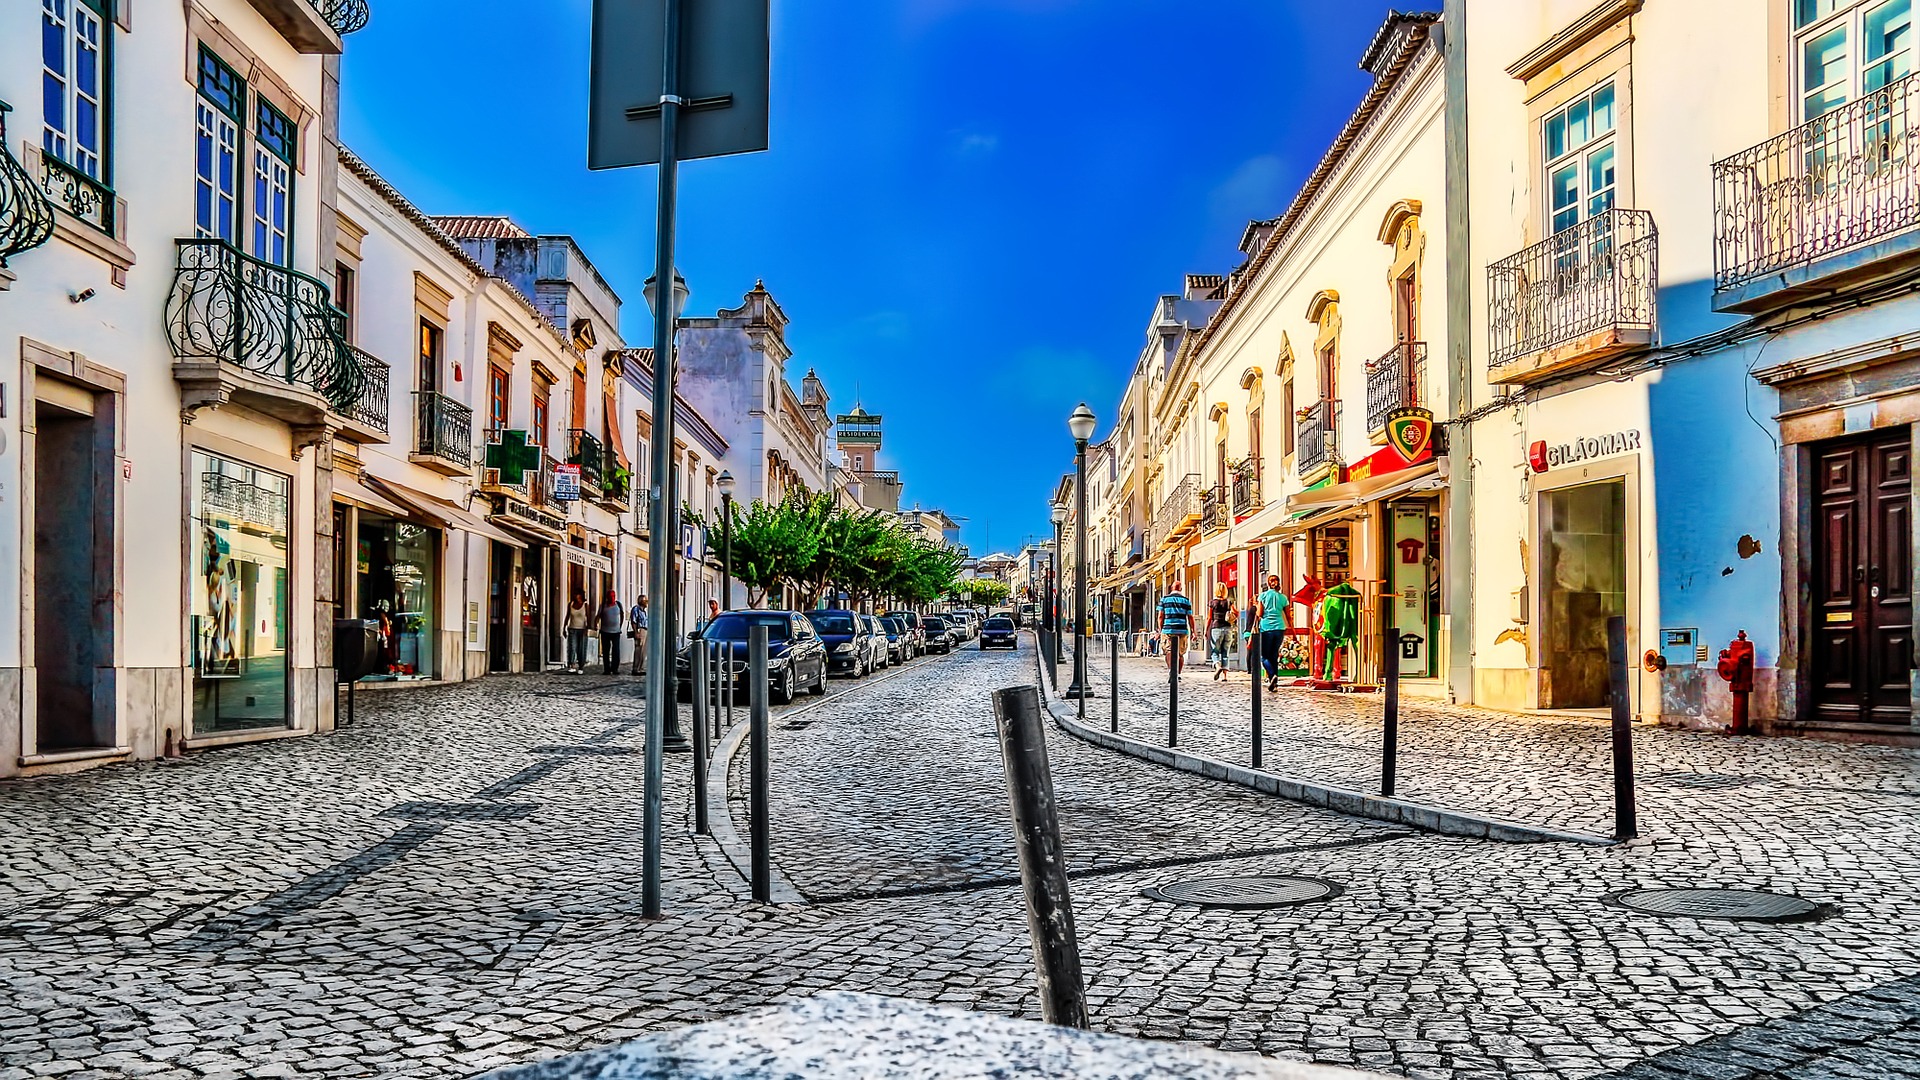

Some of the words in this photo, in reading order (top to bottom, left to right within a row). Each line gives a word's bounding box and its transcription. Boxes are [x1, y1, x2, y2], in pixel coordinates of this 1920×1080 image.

[685, 528, 691, 558] P
[1407, 546, 1414, 560] 7
[590, 558, 606, 570] CENTRAL
[1407, 642, 1414, 655] 9
